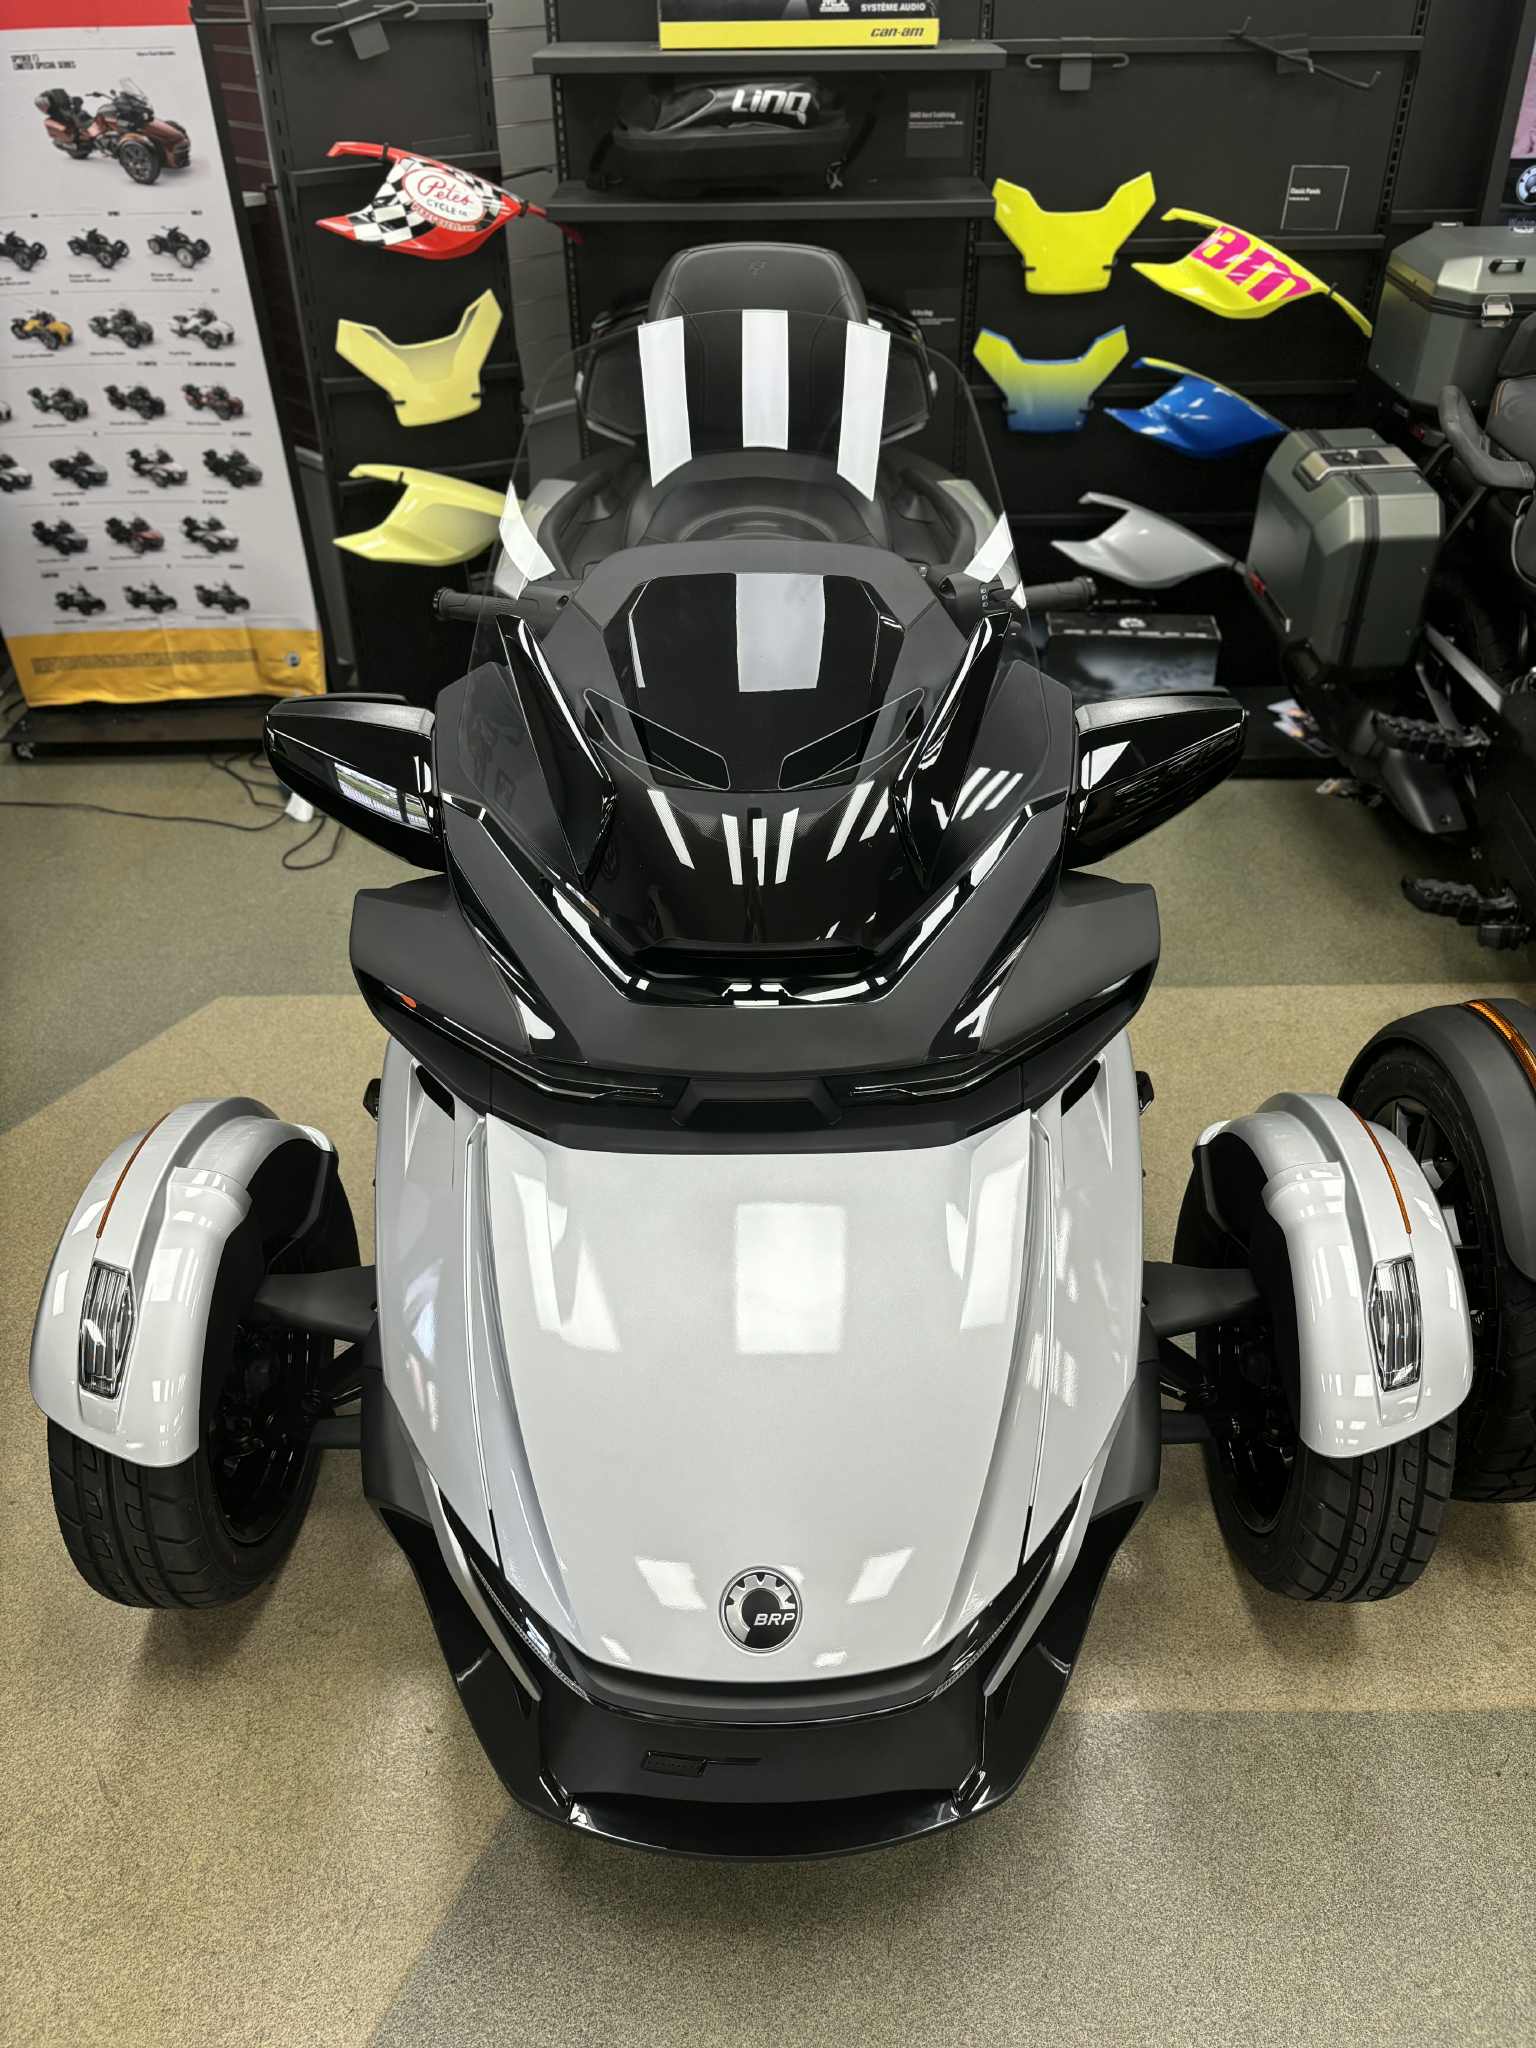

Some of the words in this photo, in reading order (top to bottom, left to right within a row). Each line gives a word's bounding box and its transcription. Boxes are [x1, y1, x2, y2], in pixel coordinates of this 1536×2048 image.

[861, 2, 899, 12] SYSTÈME
[899, 2, 926, 12] AUDIO
[870, 27, 924, 38] can-am
[426, 199, 457, 216] CYCLE
[753, 1612, 796, 1626] BRP
